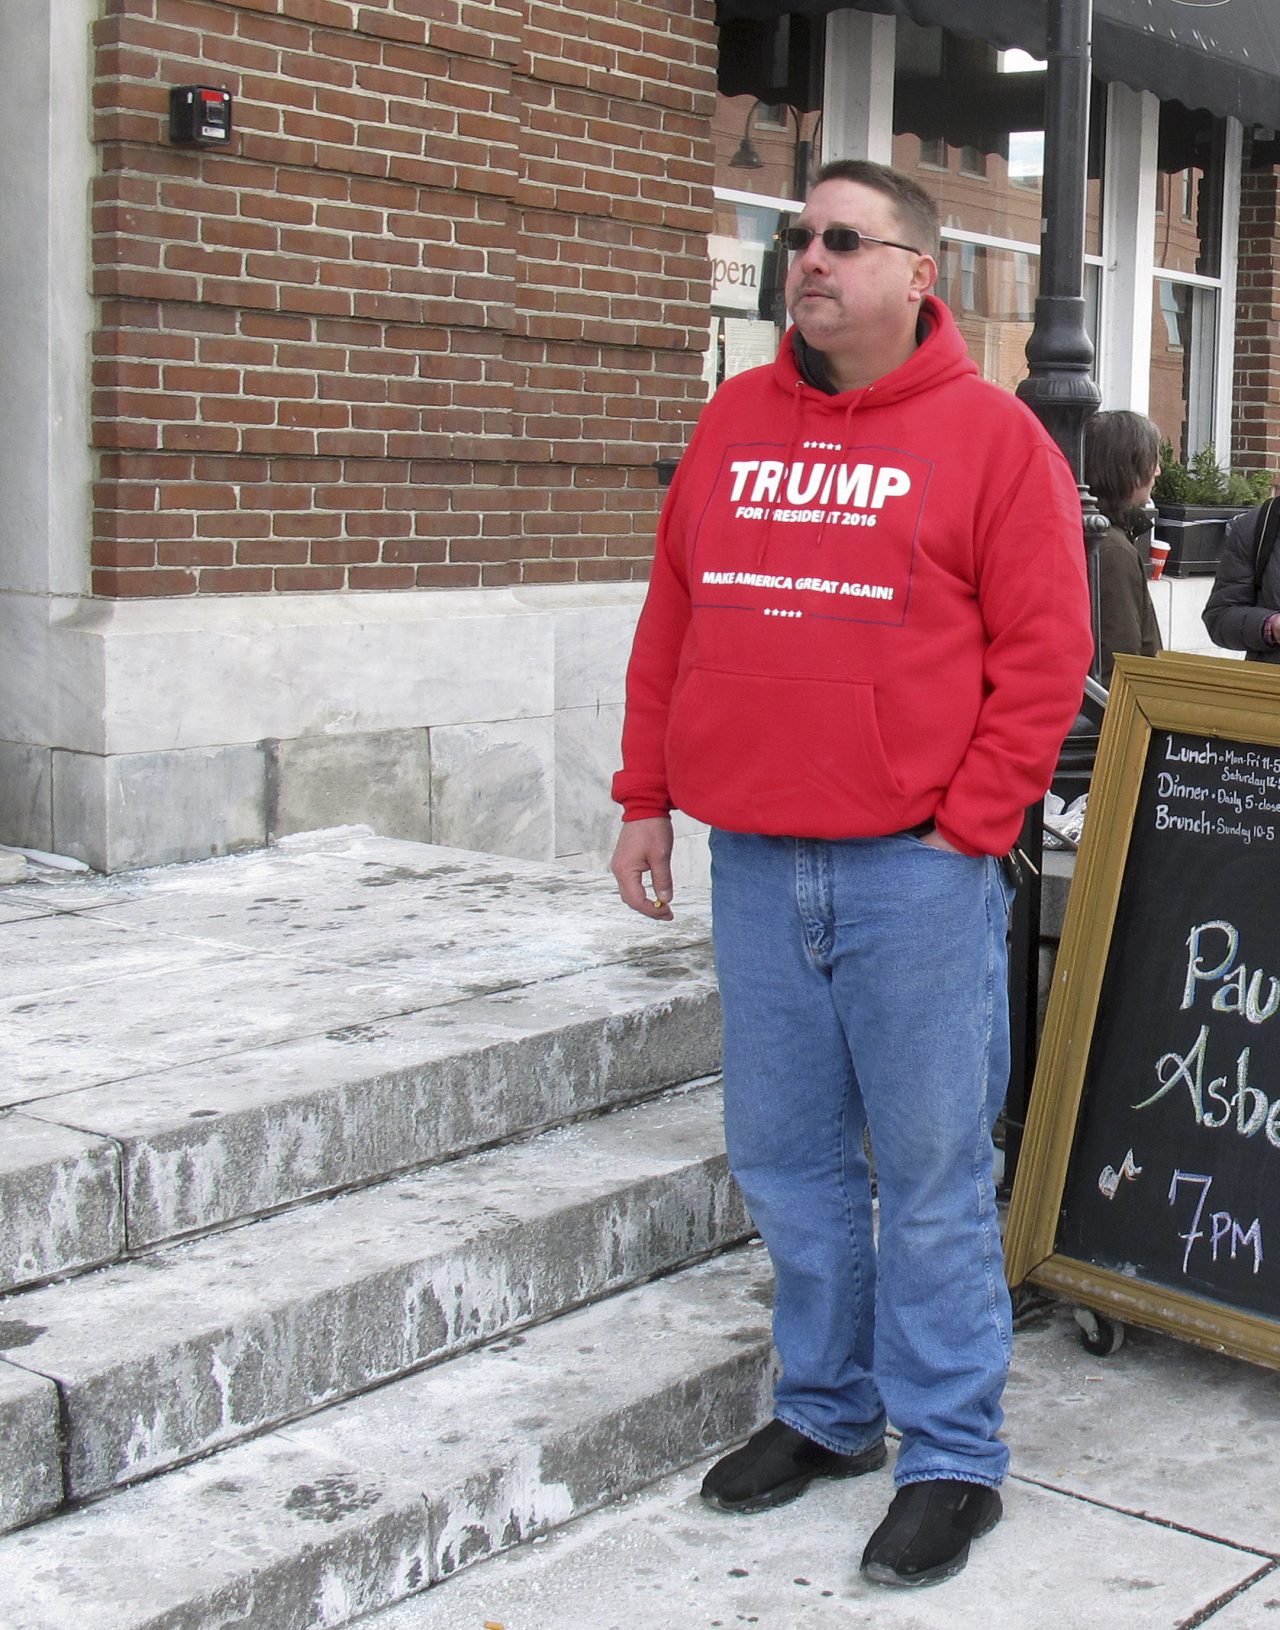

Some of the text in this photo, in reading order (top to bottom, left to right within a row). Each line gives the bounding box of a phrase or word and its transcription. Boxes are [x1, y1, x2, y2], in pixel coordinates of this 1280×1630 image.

[711, 256, 757, 290] pen
[729, 460, 911, 509] TRUMP
[734, 506, 763, 520] FOR
[840, 513, 877, 527] 2016
[702, 571, 894, 600] MAKE AMERICA GREAT AGAIN!
[1165, 734, 1217, 765] Lunch
[1157, 772, 1209, 801] Dinner
[1217, 788, 1243, 814] Daily
[1221, 766, 1266, 795] Saturday
[1155, 804, 1211, 835] Brunch
[1216, 817, 1251, 844] Sunday
